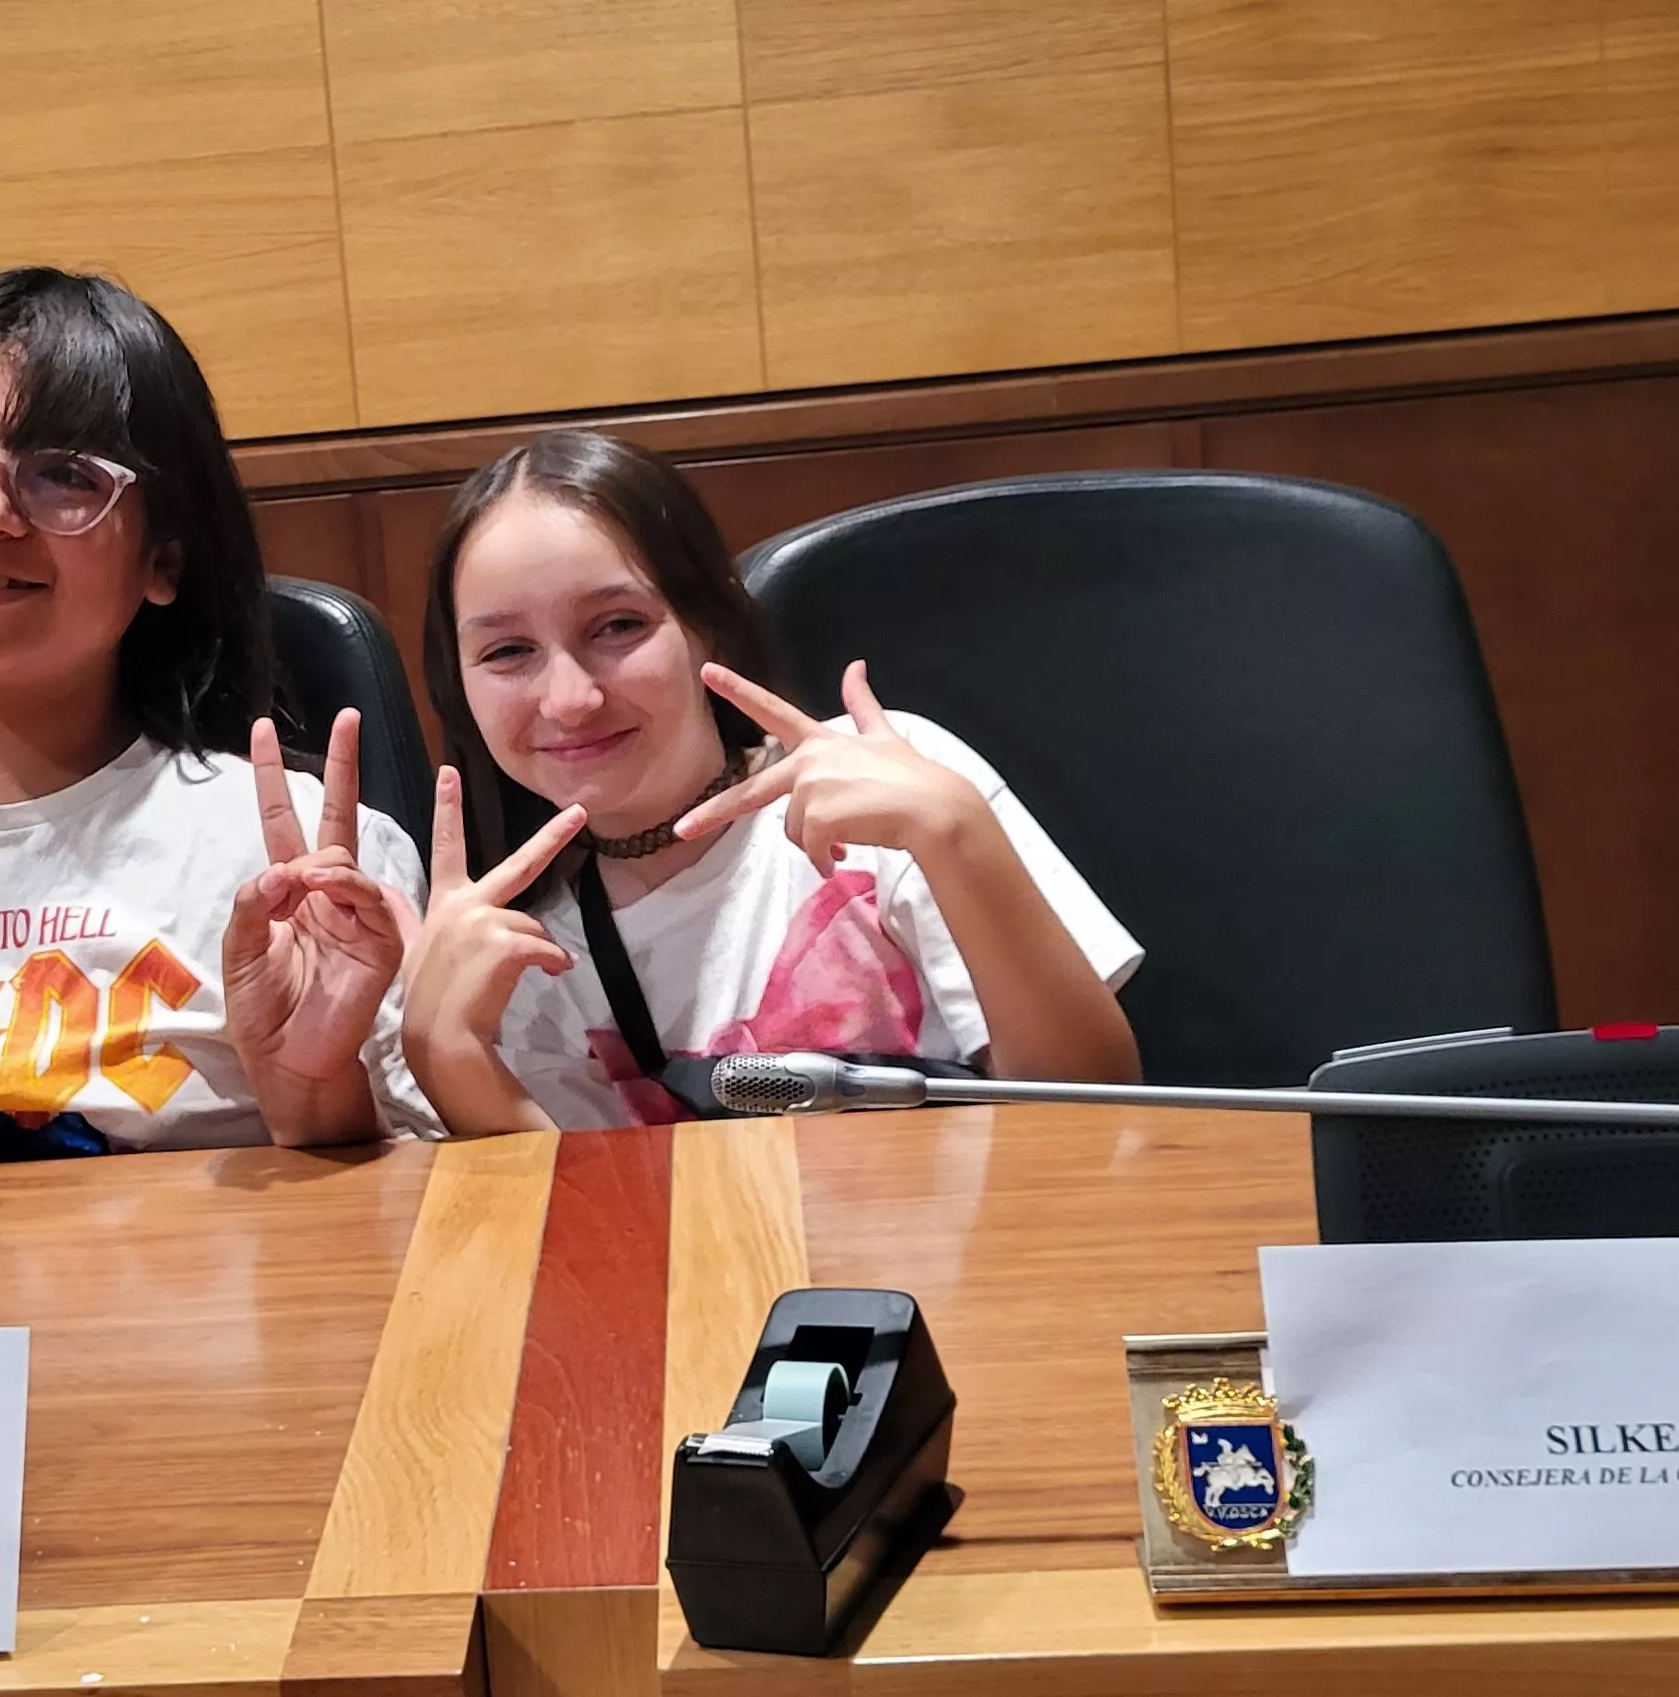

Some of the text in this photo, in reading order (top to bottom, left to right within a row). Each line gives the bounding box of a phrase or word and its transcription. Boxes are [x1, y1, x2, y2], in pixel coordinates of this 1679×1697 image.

[38, 905, 117, 945] HELL
[1545, 1422, 1679, 1456] SILKE
[1450, 1467, 1590, 1488] CONSEJERA
[1599, 1466, 1632, 1485] DE
[1640, 1466, 1669, 1484] LA
